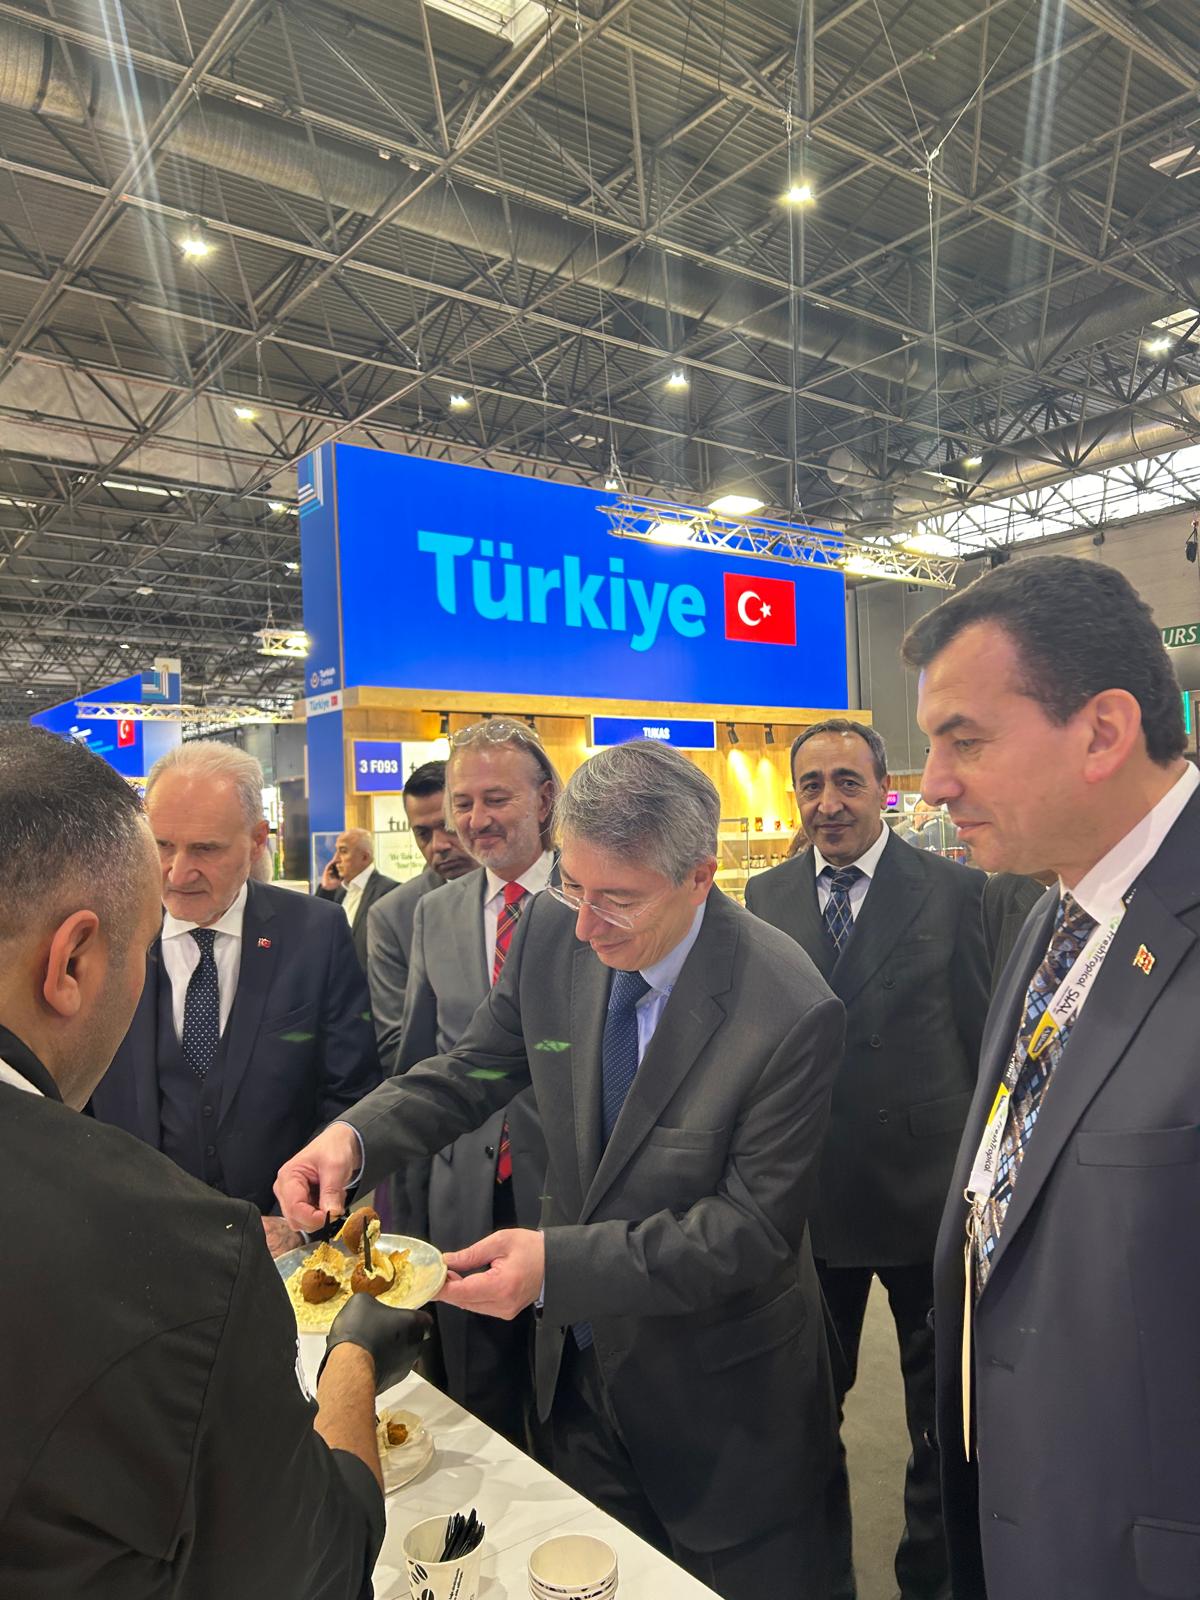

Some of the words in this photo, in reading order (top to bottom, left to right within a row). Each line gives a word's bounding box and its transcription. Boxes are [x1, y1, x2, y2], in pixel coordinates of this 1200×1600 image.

[417, 530, 706, 652] Türkiye
[1162, 626, 1197, 646] URS
[359, 760, 368, 774] 3
[370, 760, 398, 774] F093
[1076, 930, 1115, 988] FreshTropical
[1056, 989, 1080, 1015] SIAL
